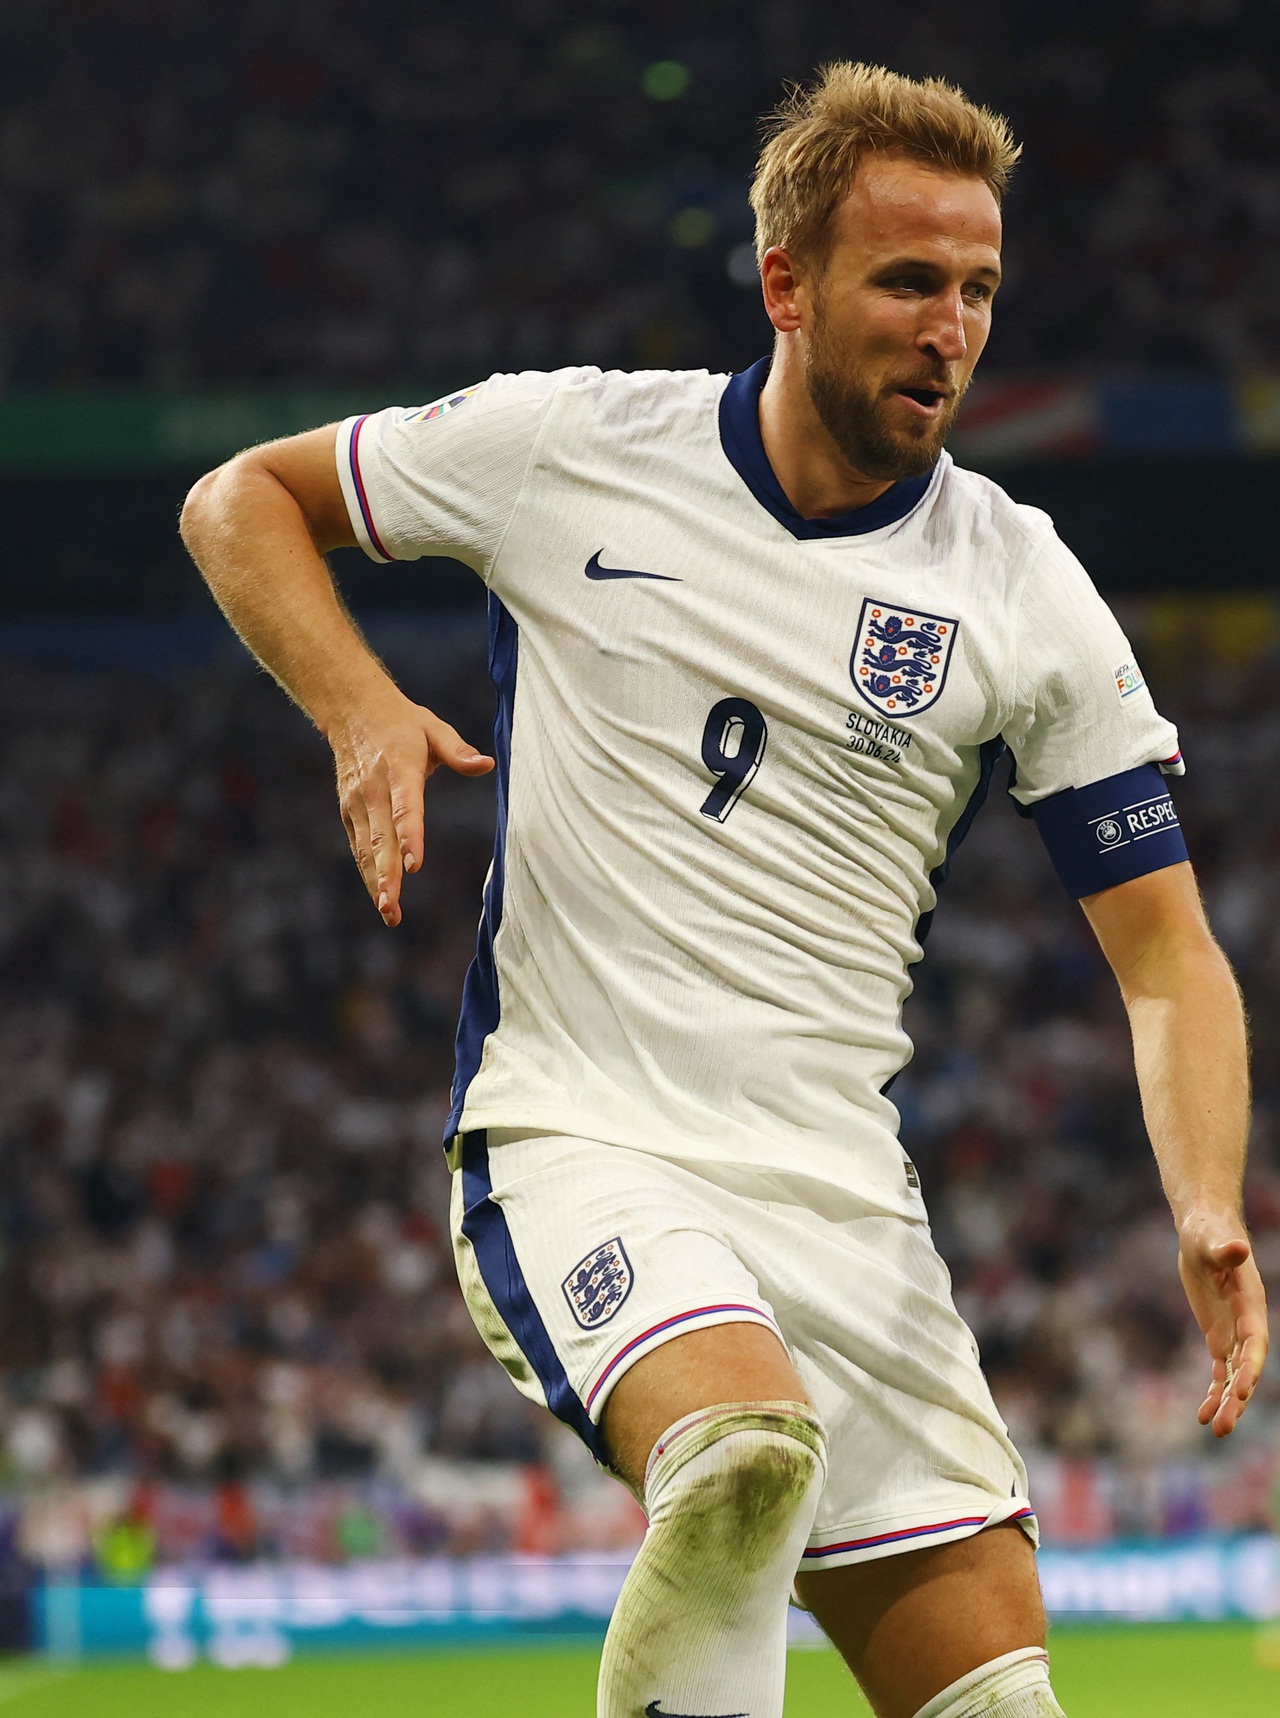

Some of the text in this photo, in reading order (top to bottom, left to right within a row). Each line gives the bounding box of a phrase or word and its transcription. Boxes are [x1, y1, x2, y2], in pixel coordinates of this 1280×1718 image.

[846, 713, 912, 748] SLOVAKIA
[700, 697, 767, 823] 9
[847, 736, 901, 763] 30.06.24
